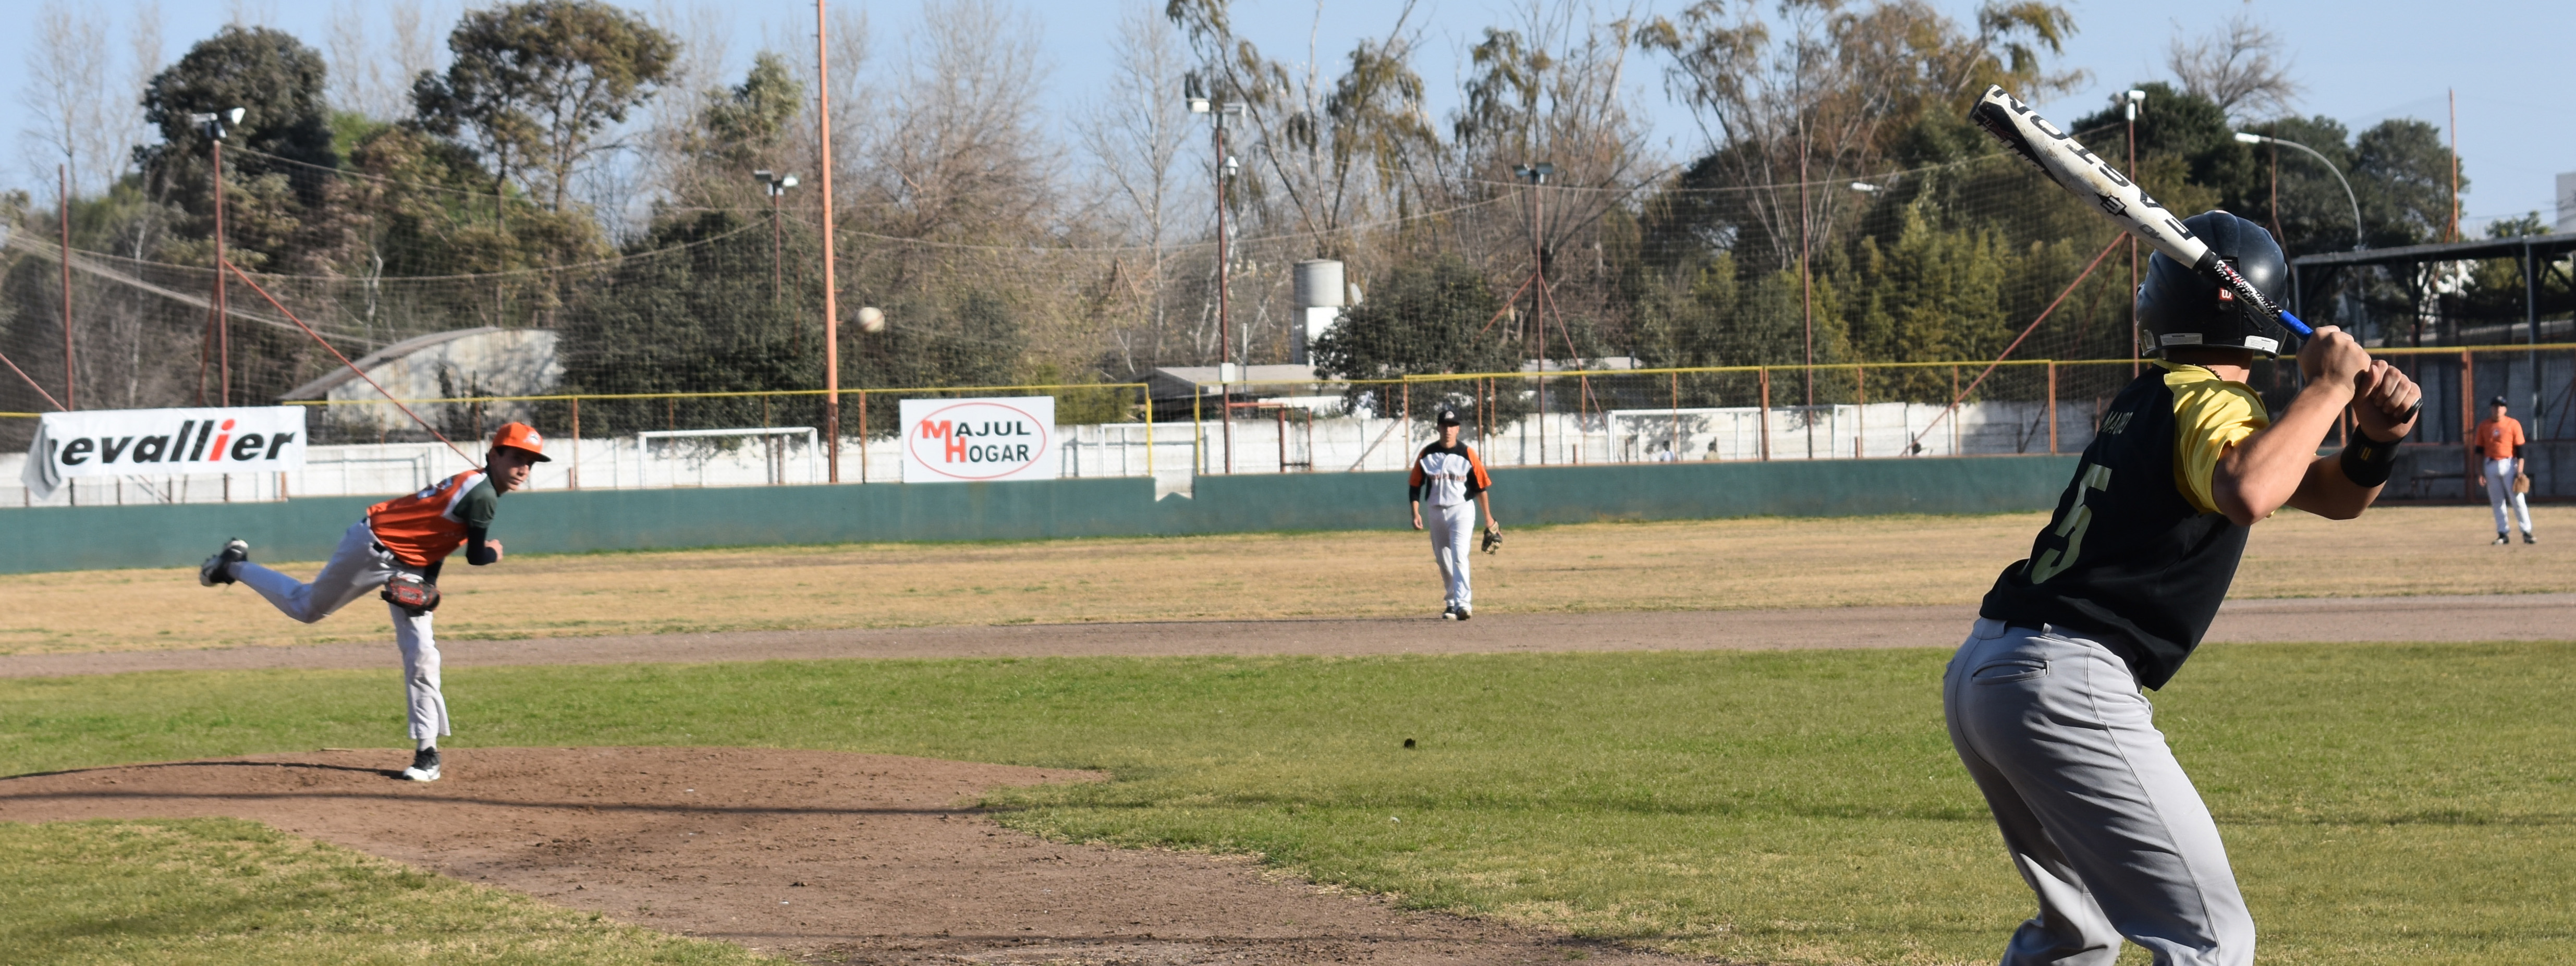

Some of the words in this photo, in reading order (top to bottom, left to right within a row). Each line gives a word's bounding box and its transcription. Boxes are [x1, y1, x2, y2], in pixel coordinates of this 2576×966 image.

[922, 420, 1031, 439] MAJUL
[945, 436, 1030, 463] HOGAR
[2031, 463, 2111, 584] 5
